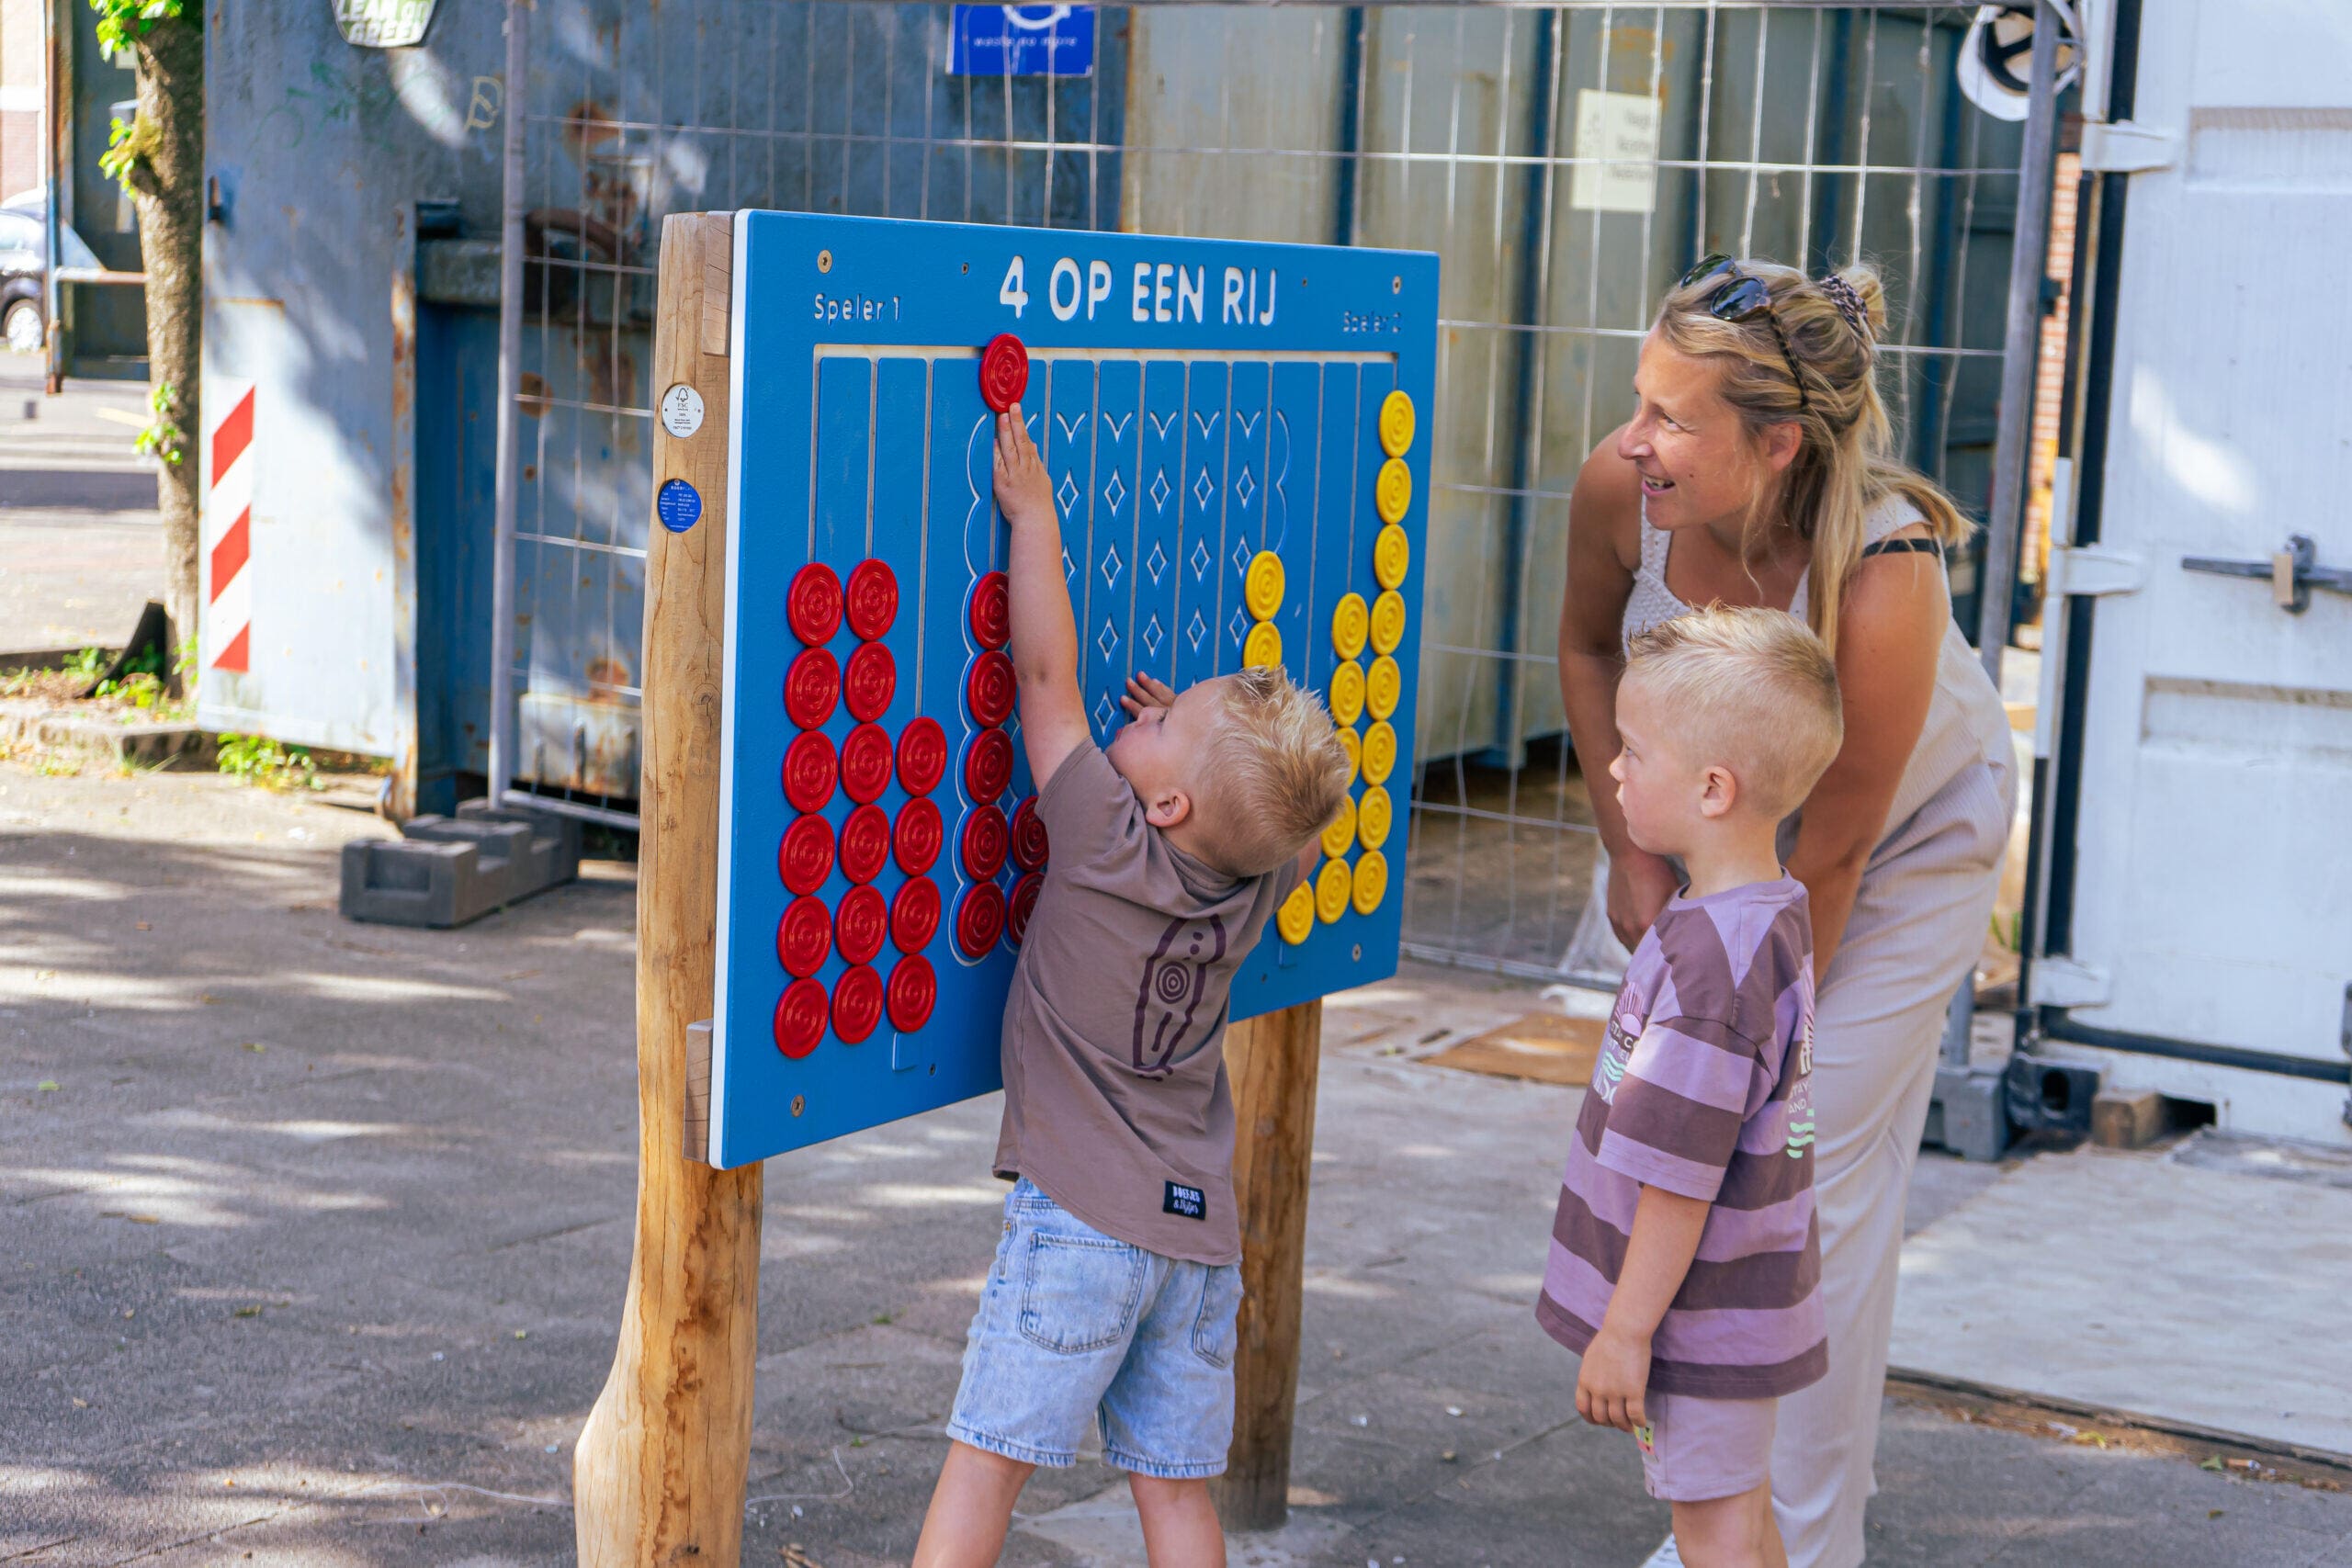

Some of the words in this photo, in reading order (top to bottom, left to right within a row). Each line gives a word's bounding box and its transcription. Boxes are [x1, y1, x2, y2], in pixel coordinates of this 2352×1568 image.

[814, 293, 884, 326] Speler
[893, 296, 900, 321] 1
[1000, 254, 1029, 319] 4
[1049, 256, 1113, 321] OP
[1132, 262, 1205, 324] EEN
[1223, 266, 1276, 326] RIJ
